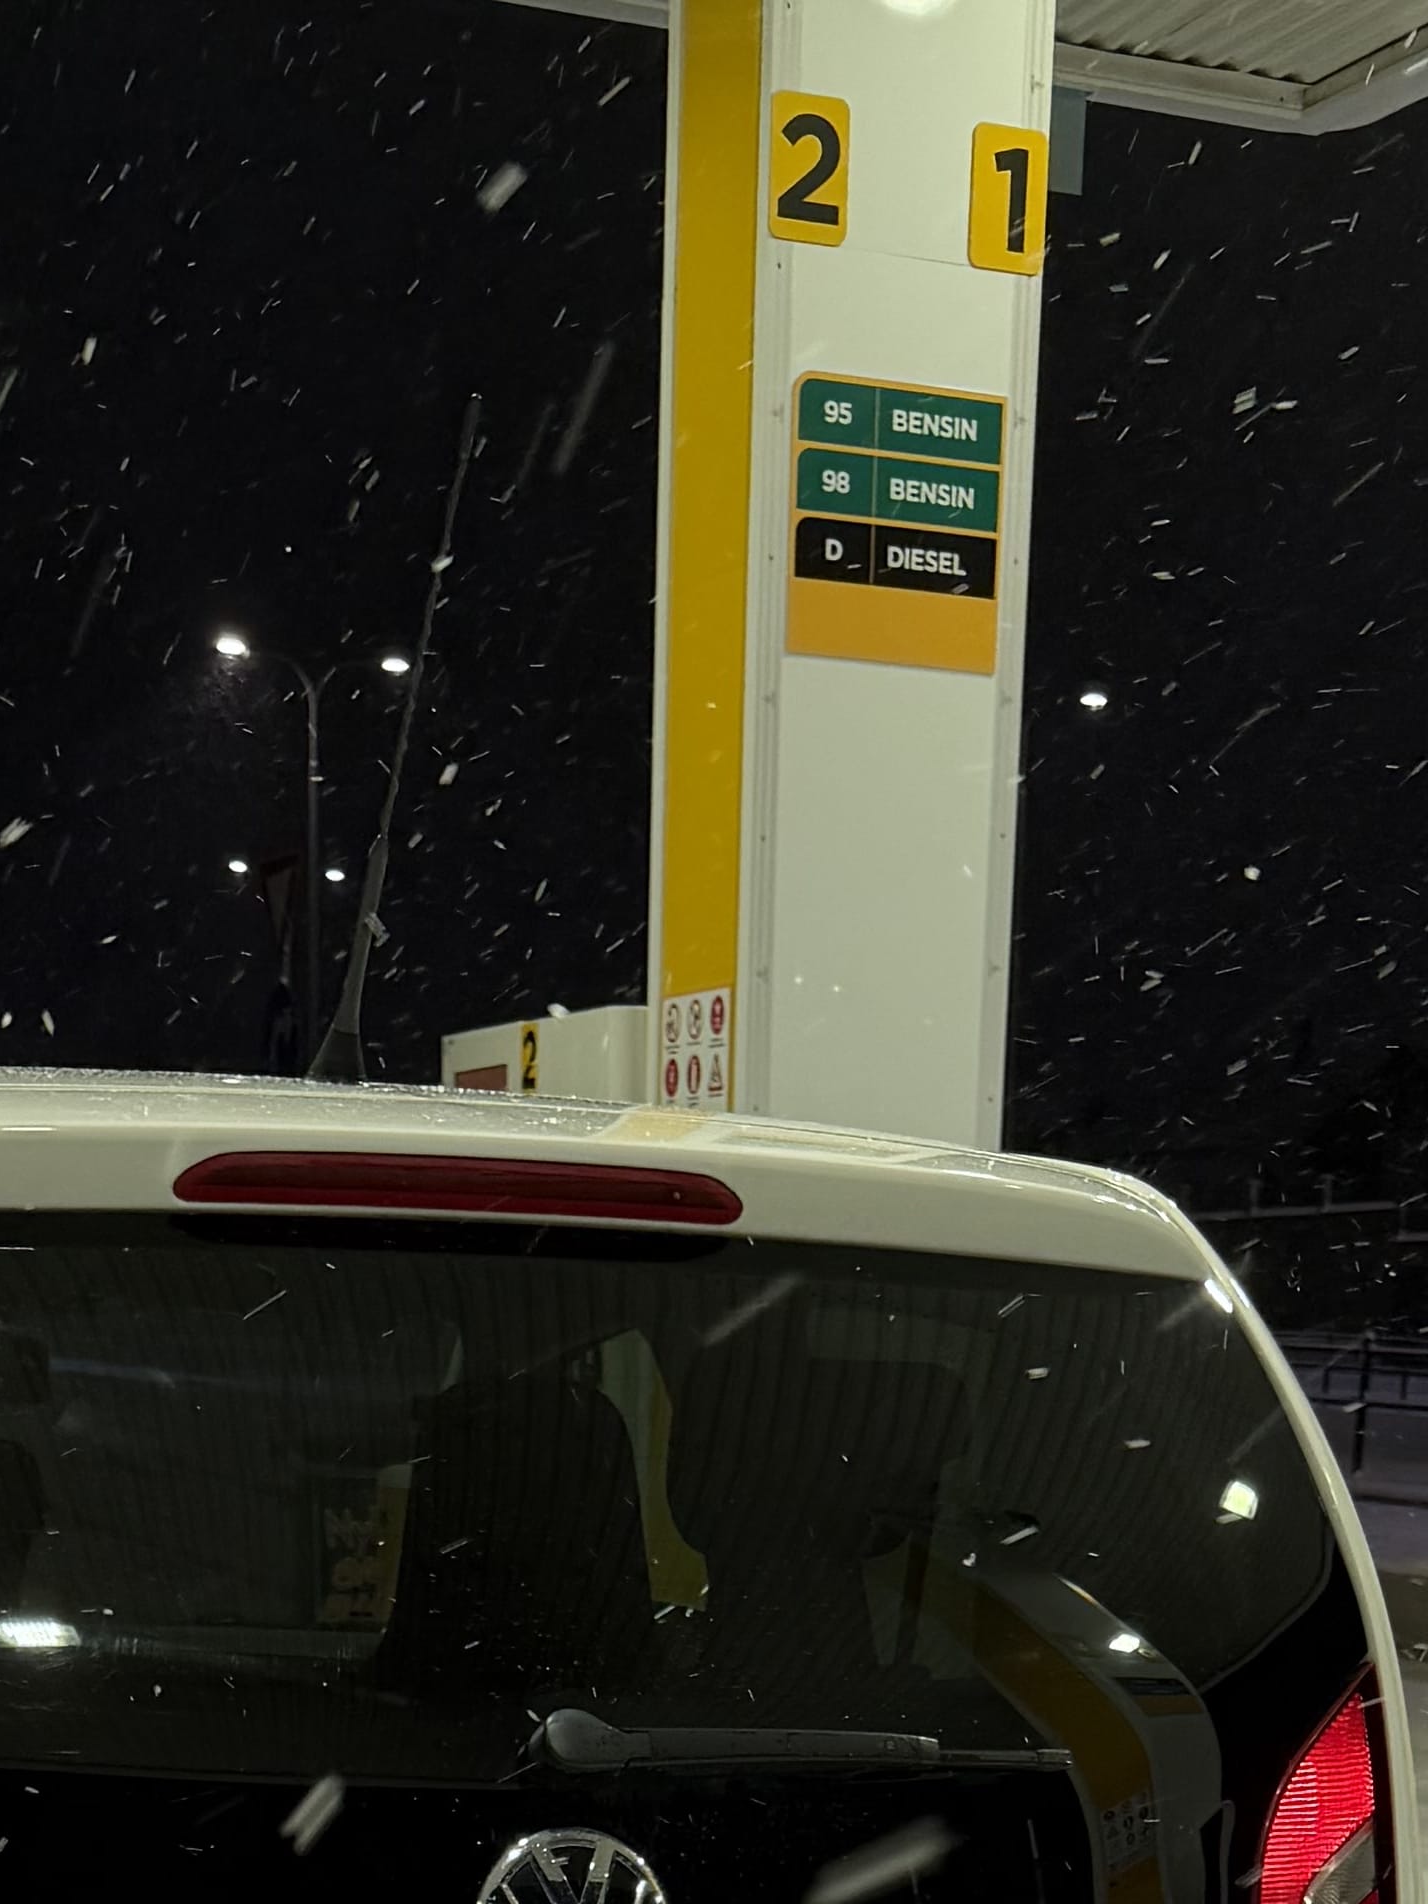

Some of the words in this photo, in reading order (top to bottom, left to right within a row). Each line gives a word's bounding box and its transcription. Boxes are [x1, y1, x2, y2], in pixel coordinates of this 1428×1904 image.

[777, 113, 841, 225] 2
[995, 148, 1029, 253] 1
[824, 400, 853, 425] 95
[892, 409, 978, 442] BENSIN
[822, 469, 851, 494] 98
[889, 478, 974, 509] BENSIN
[825, 538, 843, 561] D
[887, 546, 967, 576] DIESEL
